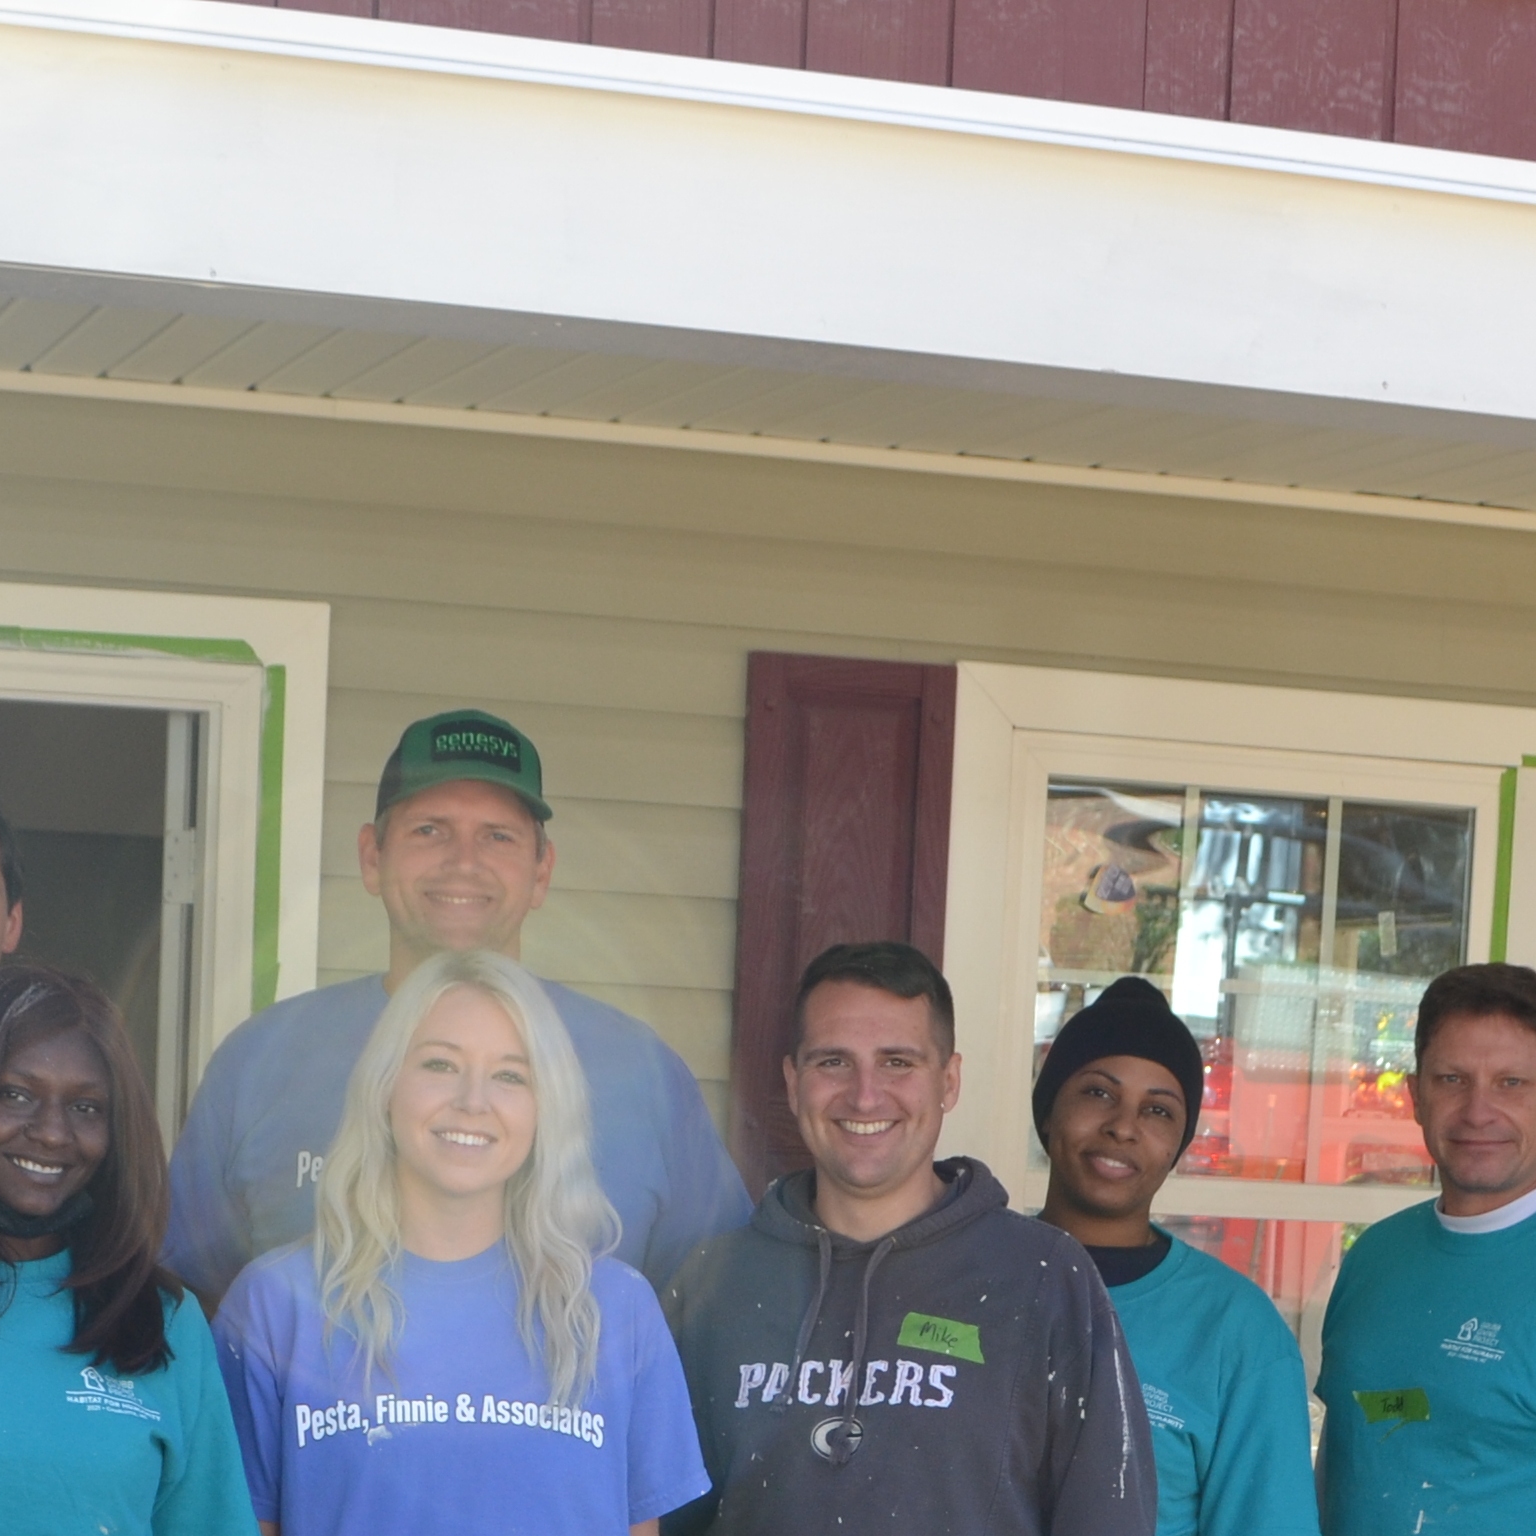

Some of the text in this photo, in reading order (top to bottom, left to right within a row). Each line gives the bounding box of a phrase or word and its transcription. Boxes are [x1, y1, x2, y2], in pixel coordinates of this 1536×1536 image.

[435, 731, 519, 759] genesys
[919, 1320, 959, 1350] Mike
[733, 1358, 958, 1409] PACKERS
[1380, 1395, 1405, 1414] Todd
[296, 1392, 606, 1449] Pesta, Finnie & Associates
